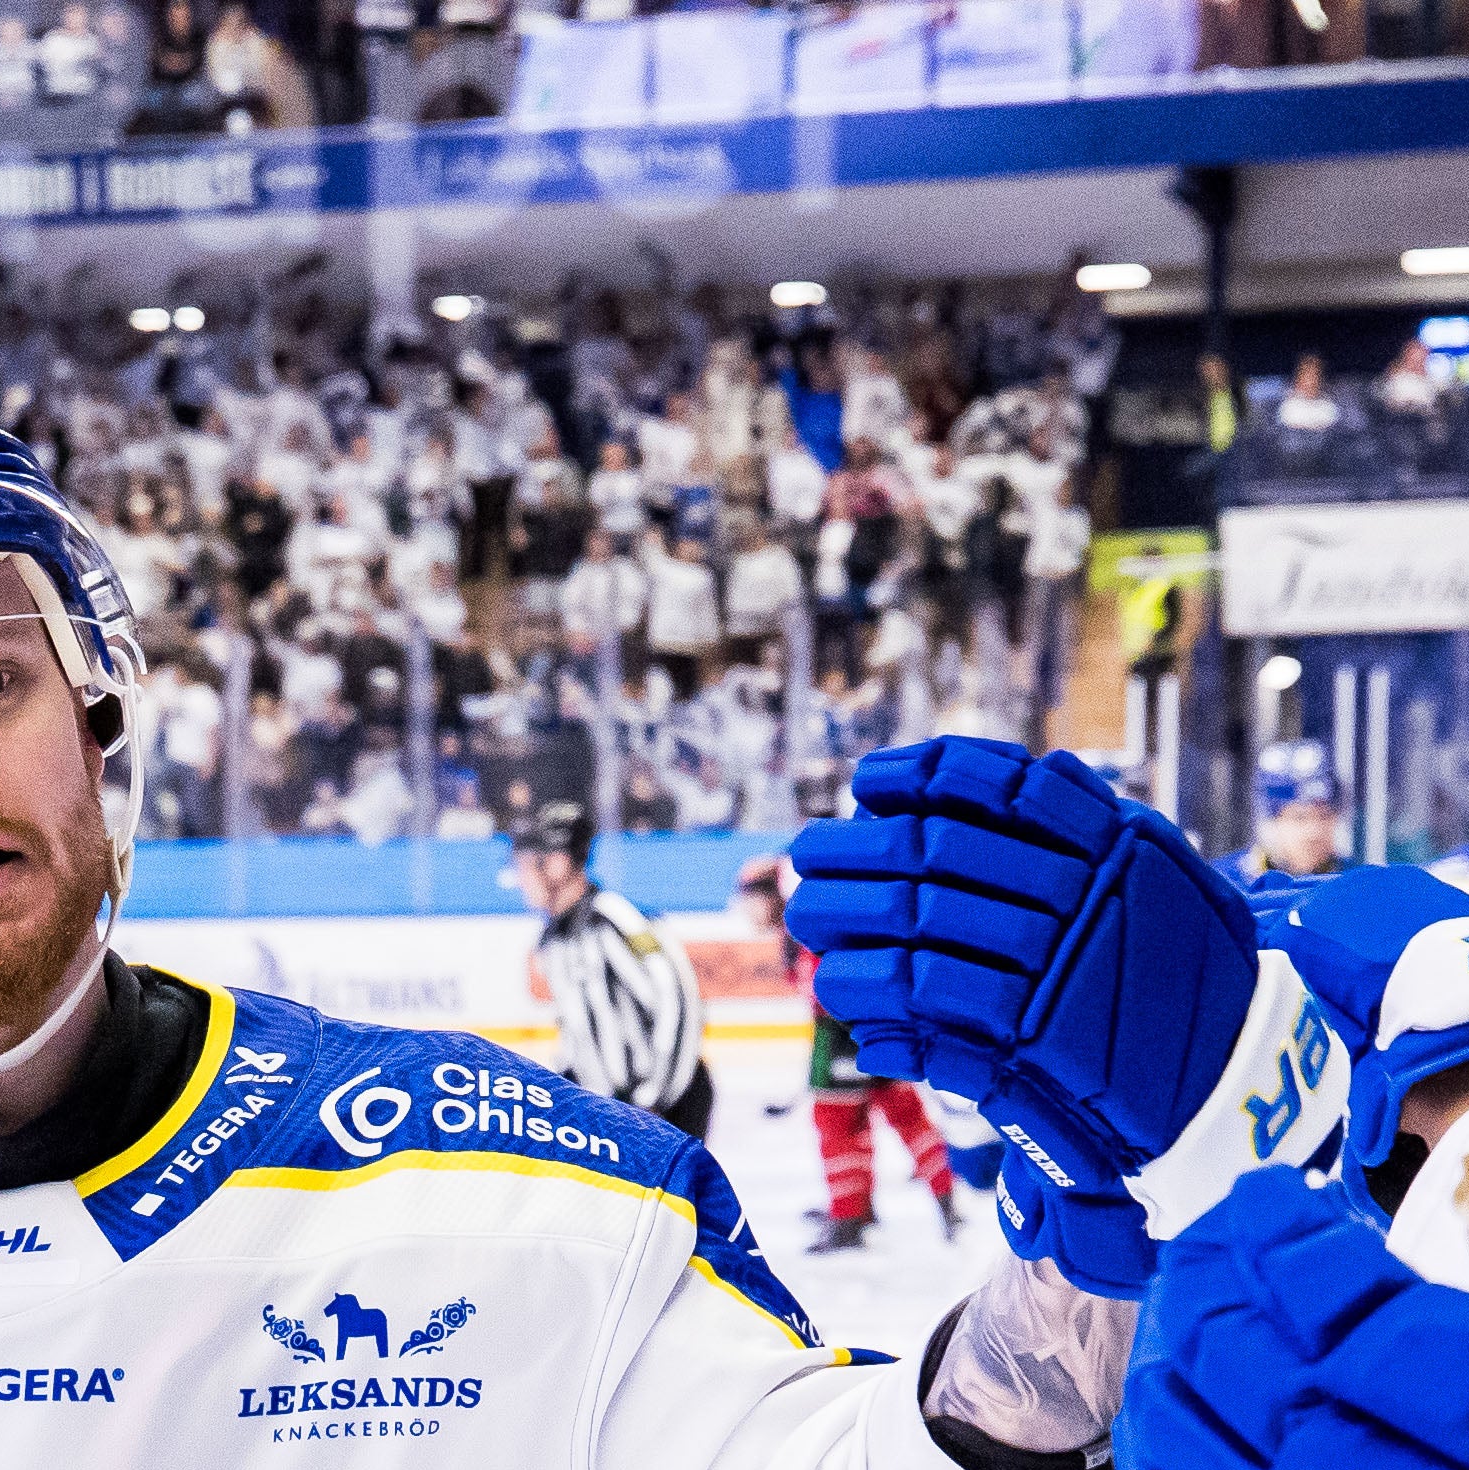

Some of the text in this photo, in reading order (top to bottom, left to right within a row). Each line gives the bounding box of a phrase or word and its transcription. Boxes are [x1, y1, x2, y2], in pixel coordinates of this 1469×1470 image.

[432, 1062, 555, 1109] Clas
[432, 1098, 620, 1163] Ohlson
[238, 1377, 483, 1418] LEKSANDS
[273, 1418, 440, 1443] KNÄCKEBRÖD
